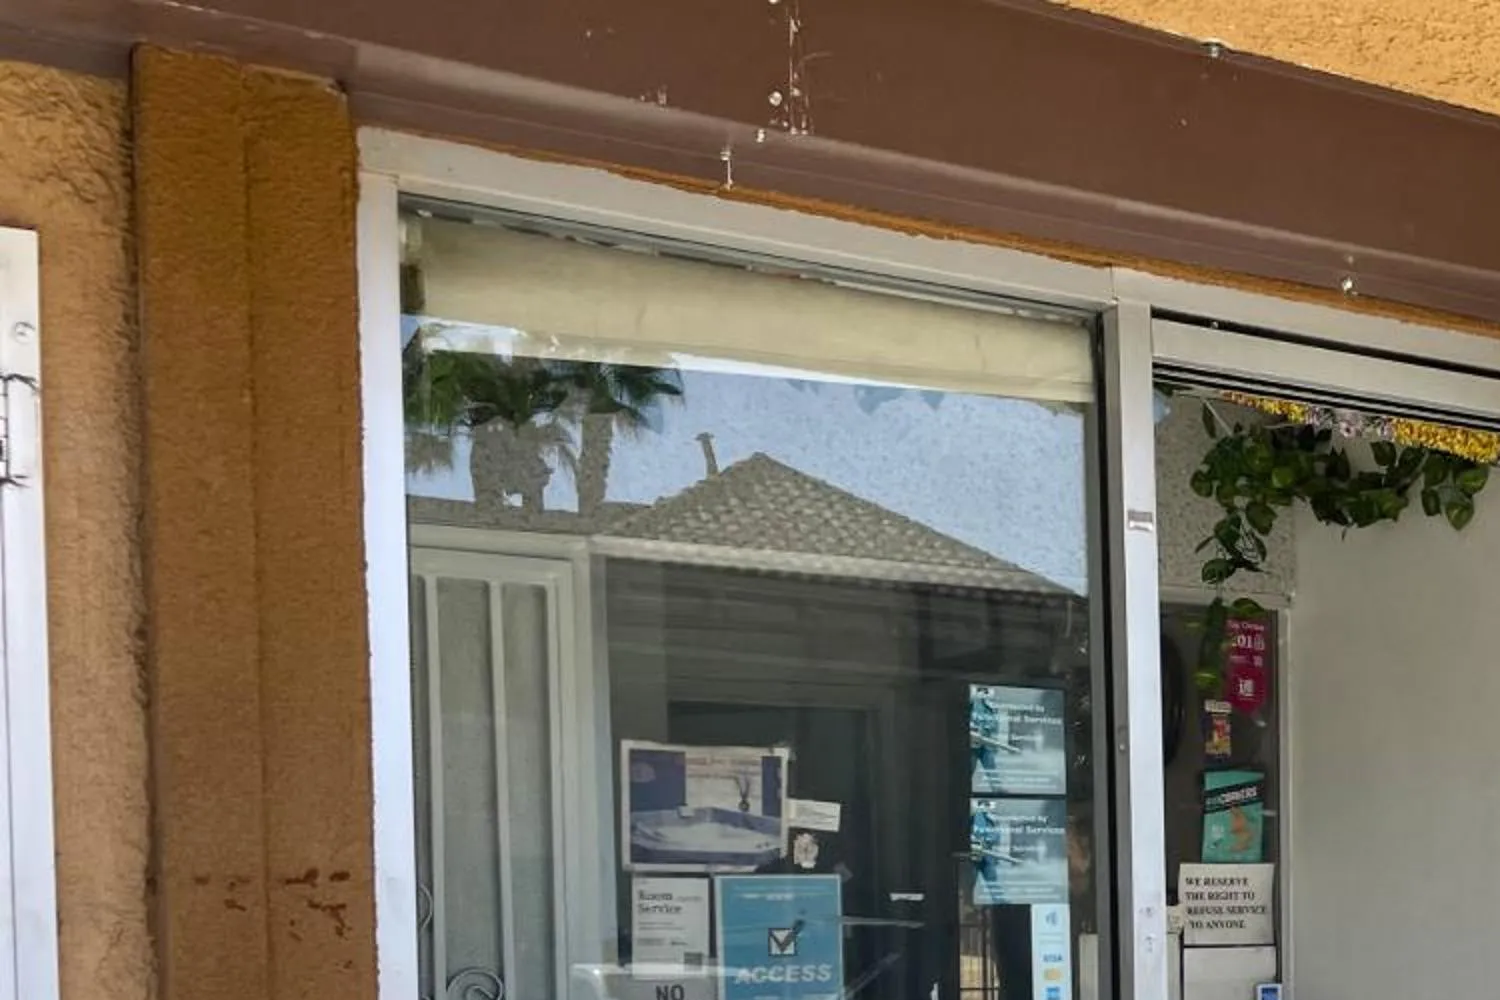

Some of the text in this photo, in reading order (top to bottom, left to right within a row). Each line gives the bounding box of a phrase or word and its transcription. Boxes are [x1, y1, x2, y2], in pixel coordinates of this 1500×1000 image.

[1185, 877, 1248, 886] WE RESERVE
[1185, 891, 1255, 900] THE RIGHT TO
[637, 901, 683, 915] Service
[1187, 905, 1267, 915] REFUSE SERVICE
[1189, 919, 1245, 929] TO ANYONE
[734, 964, 833, 985] ACCESS
